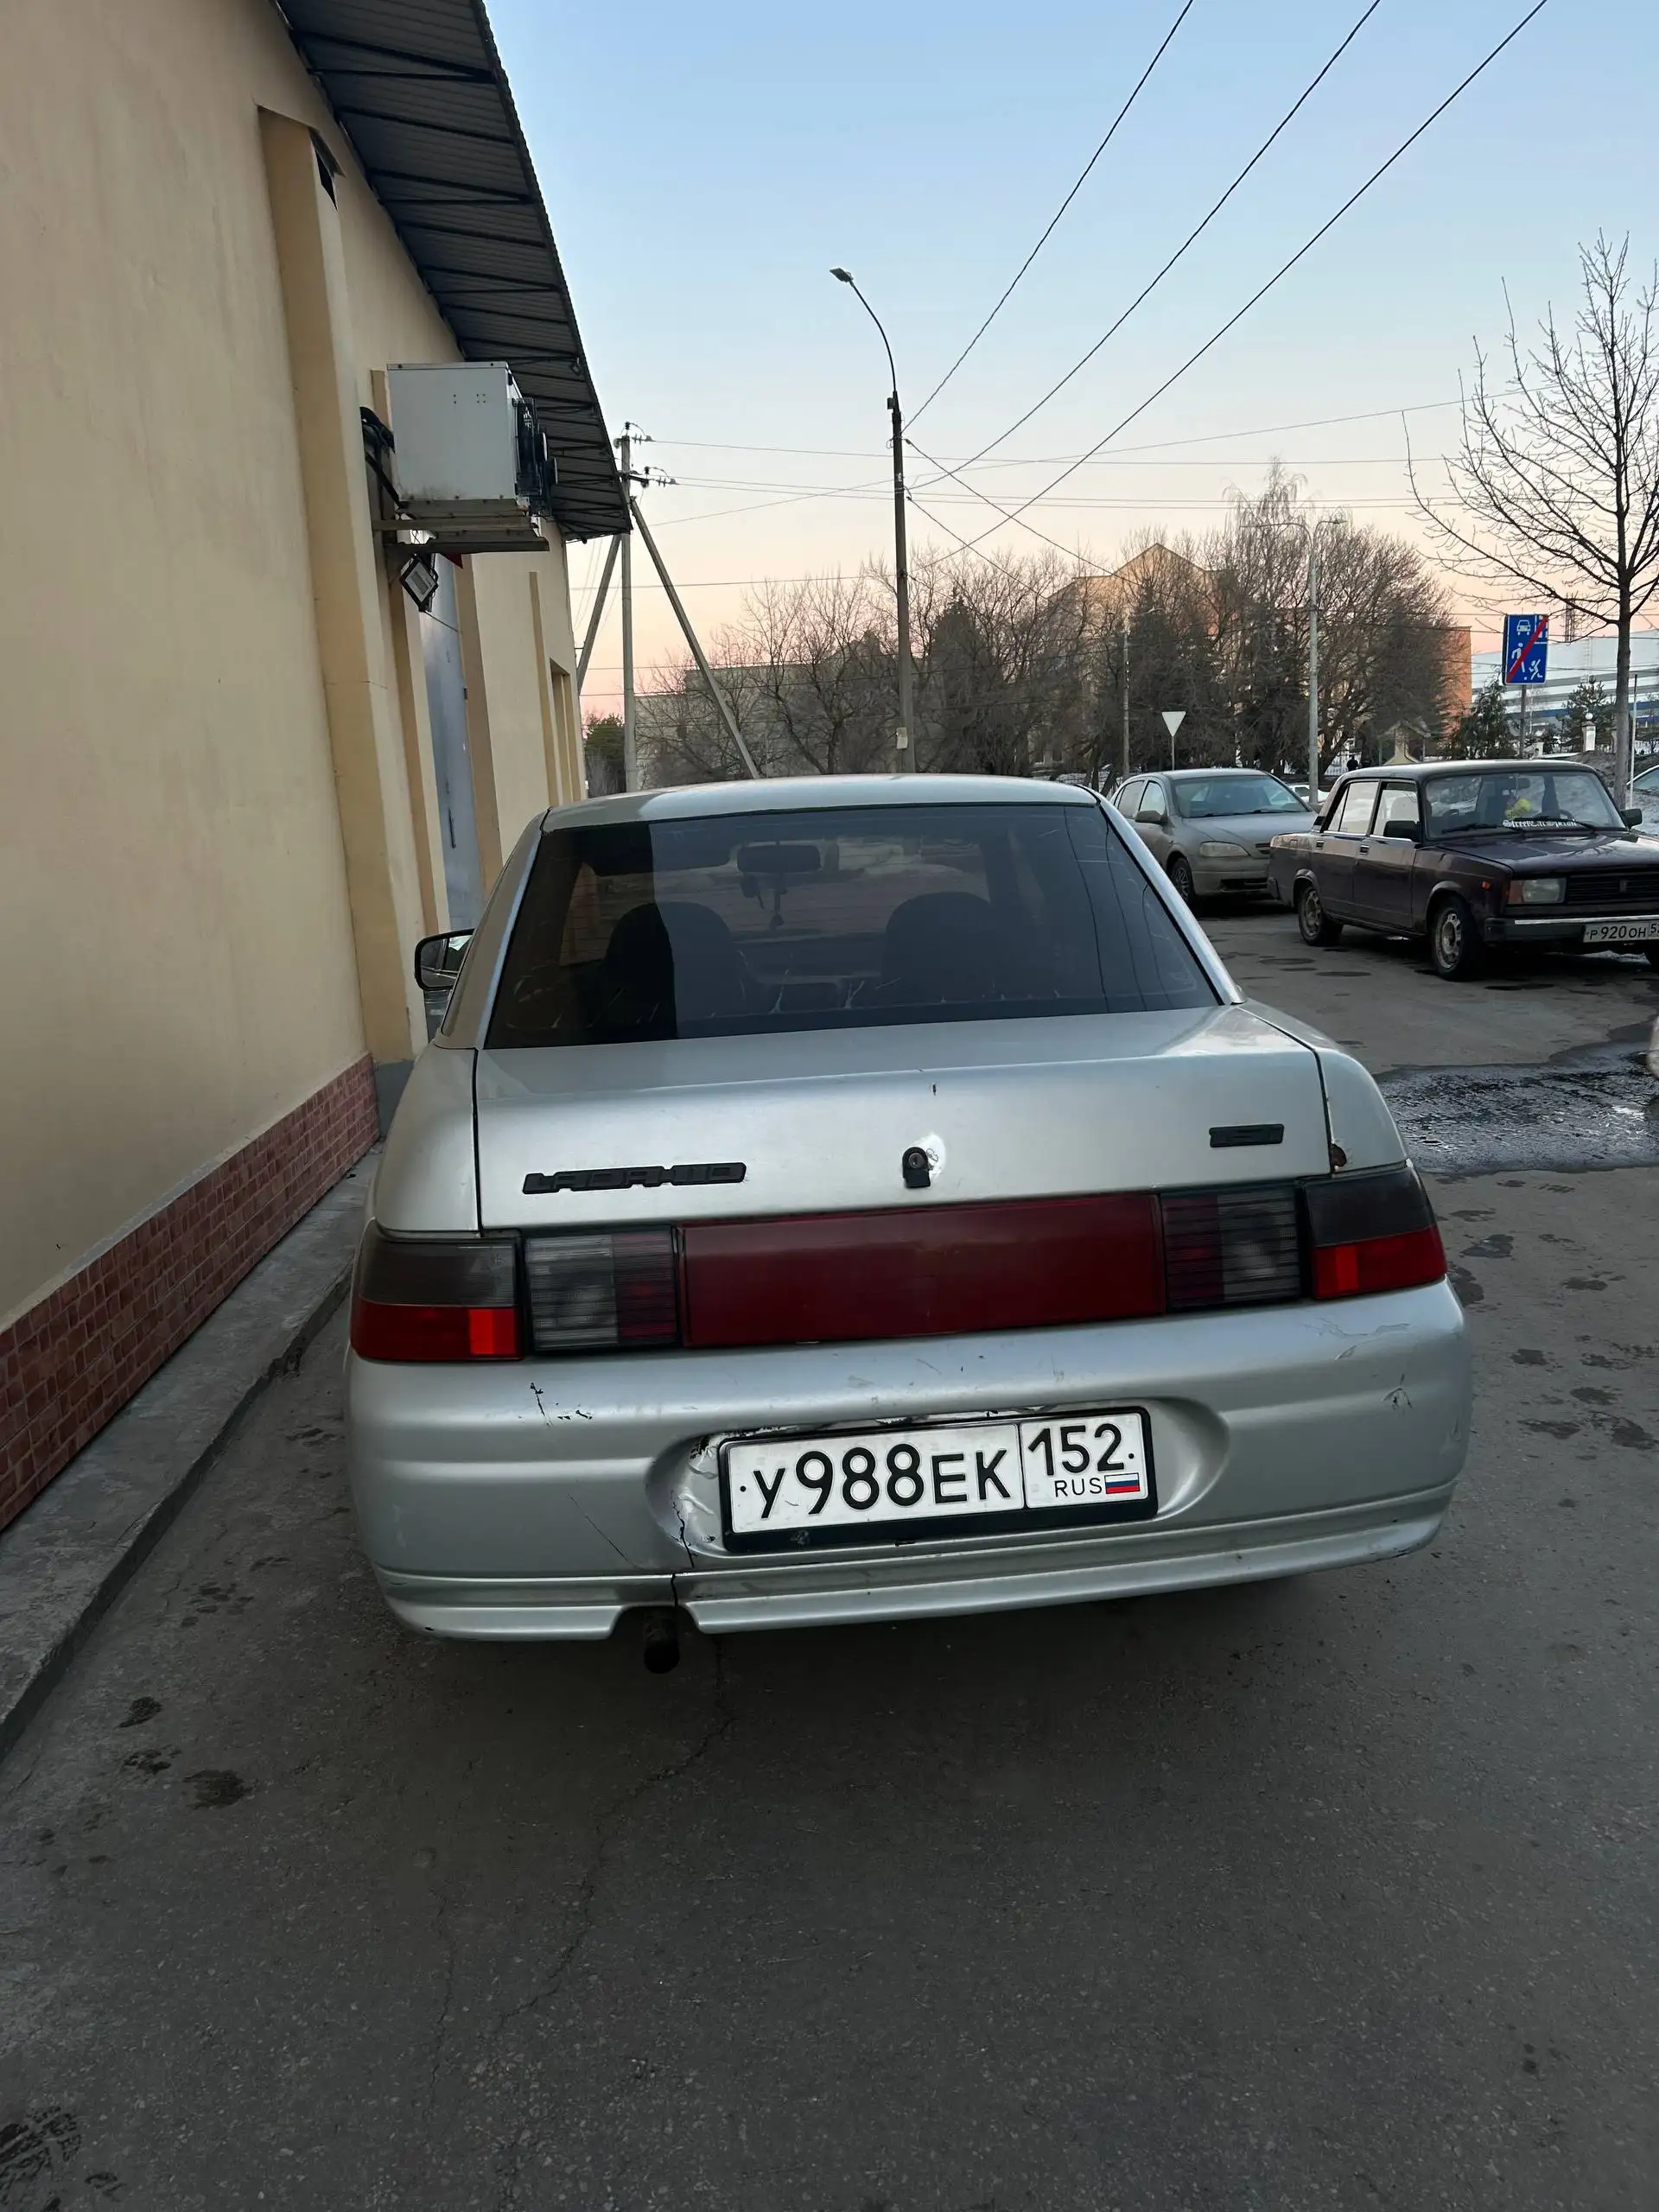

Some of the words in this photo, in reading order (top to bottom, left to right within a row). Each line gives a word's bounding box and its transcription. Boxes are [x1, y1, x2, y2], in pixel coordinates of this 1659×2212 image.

[752, 1443, 1011, 1519] У988ЕК
[1027, 1422, 1125, 1477] 152
[1054, 1477, 1103, 1497] RUS
